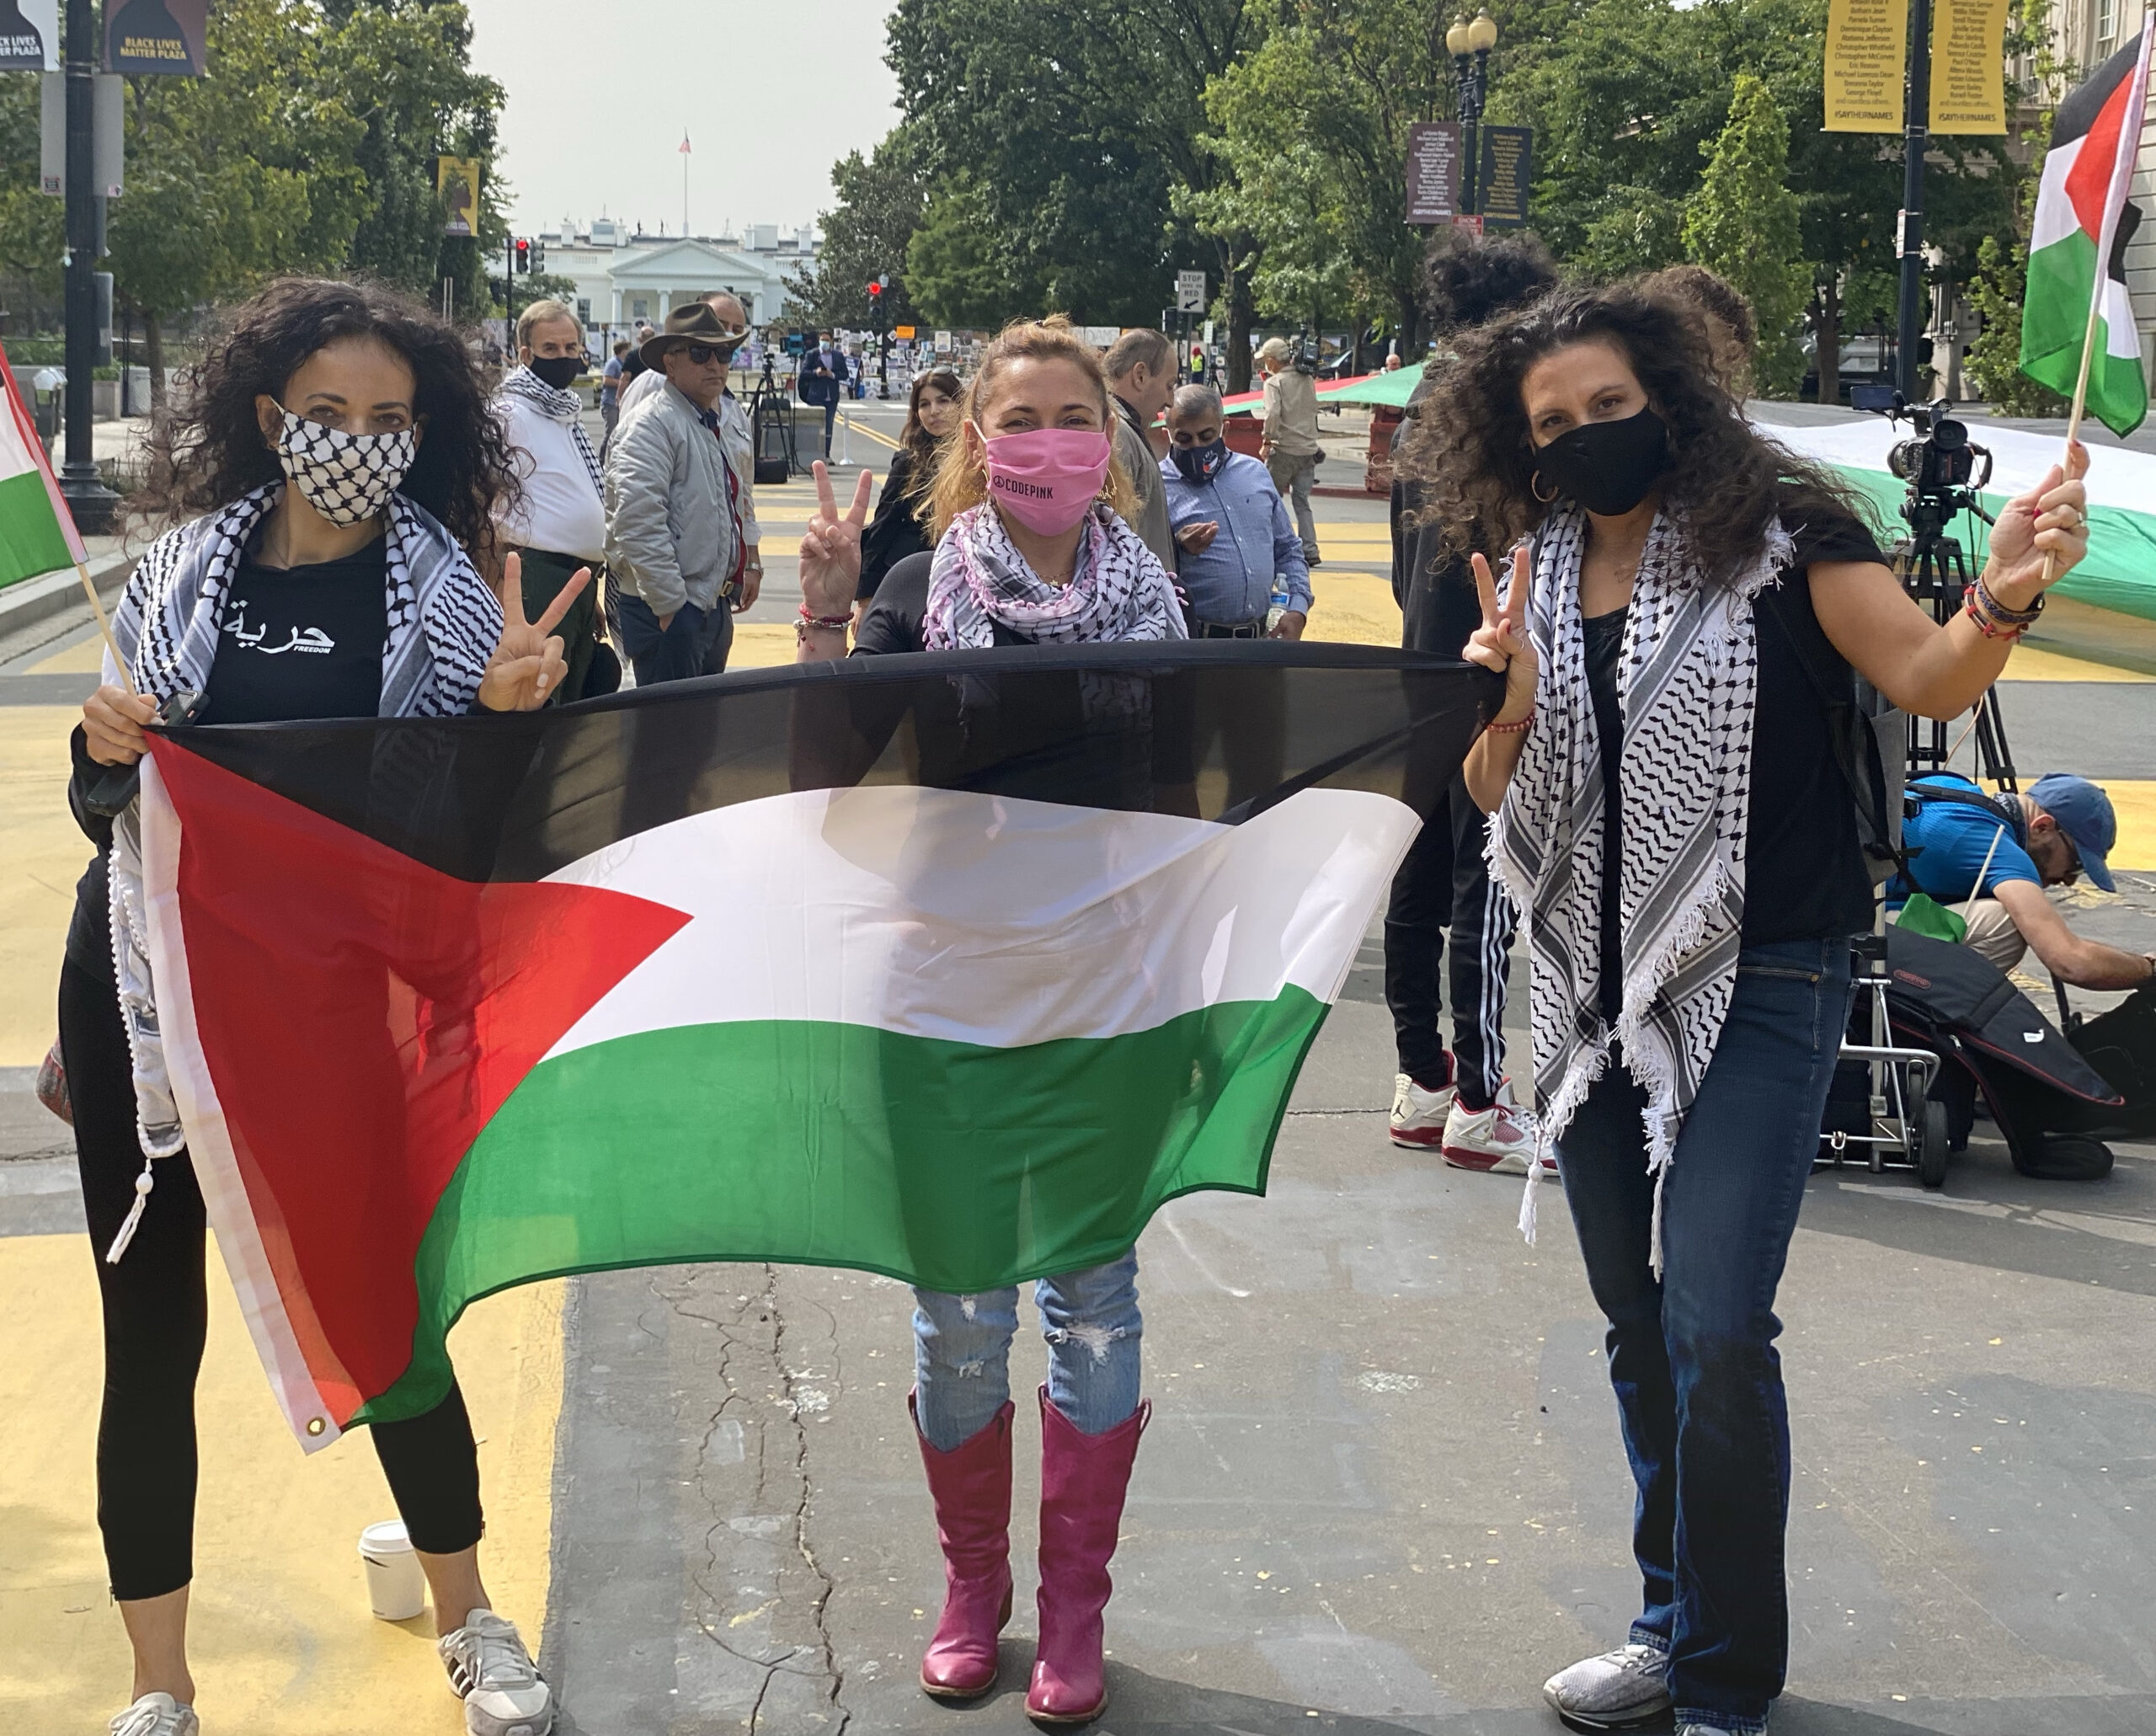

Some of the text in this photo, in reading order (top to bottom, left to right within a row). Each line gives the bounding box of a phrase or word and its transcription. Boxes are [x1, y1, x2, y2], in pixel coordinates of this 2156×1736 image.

[11, 35, 36, 46] LIVES
[125, 36, 182, 50] BLACK LIVES
[13, 45, 41, 56] PLAZA
[120, 46, 187, 60] MATTER PLAZA
[1006, 478, 1054, 499] CODEPINK
[222, 600, 335, 654] حرية
[293, 646, 331, 654] FREEDOM
